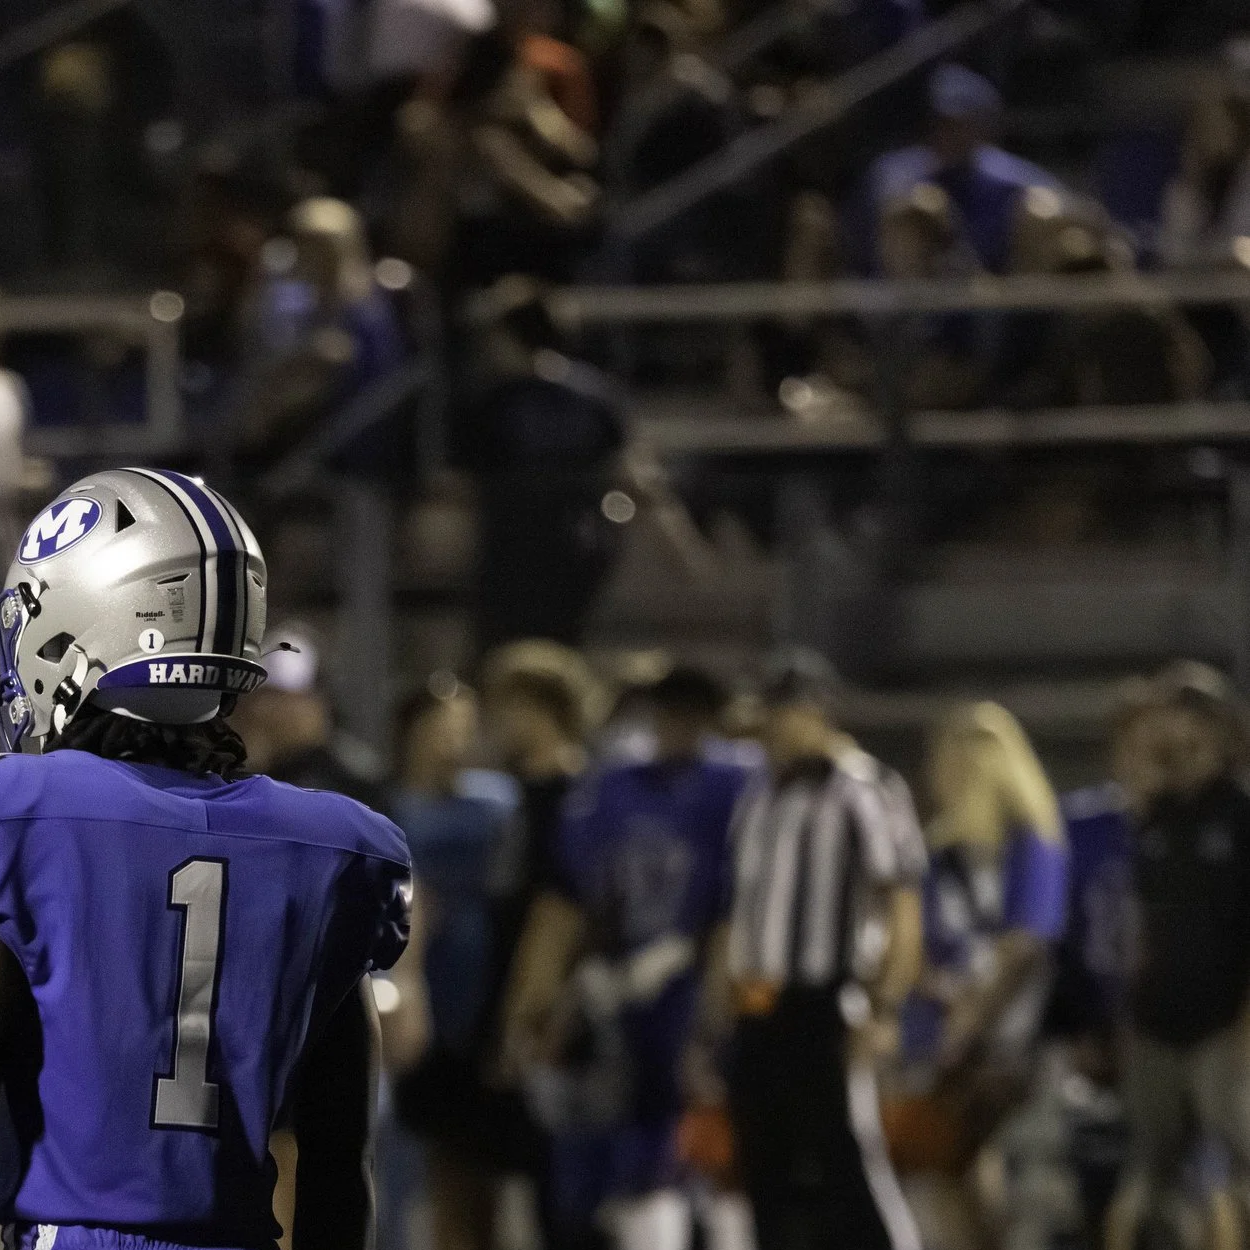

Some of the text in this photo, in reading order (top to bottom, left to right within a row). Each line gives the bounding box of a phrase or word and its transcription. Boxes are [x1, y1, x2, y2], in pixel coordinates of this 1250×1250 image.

[21, 499, 94, 559] M
[148, 632, 155, 650] 1
[148, 663, 220, 685] HARD
[152, 857, 225, 1129] 1
